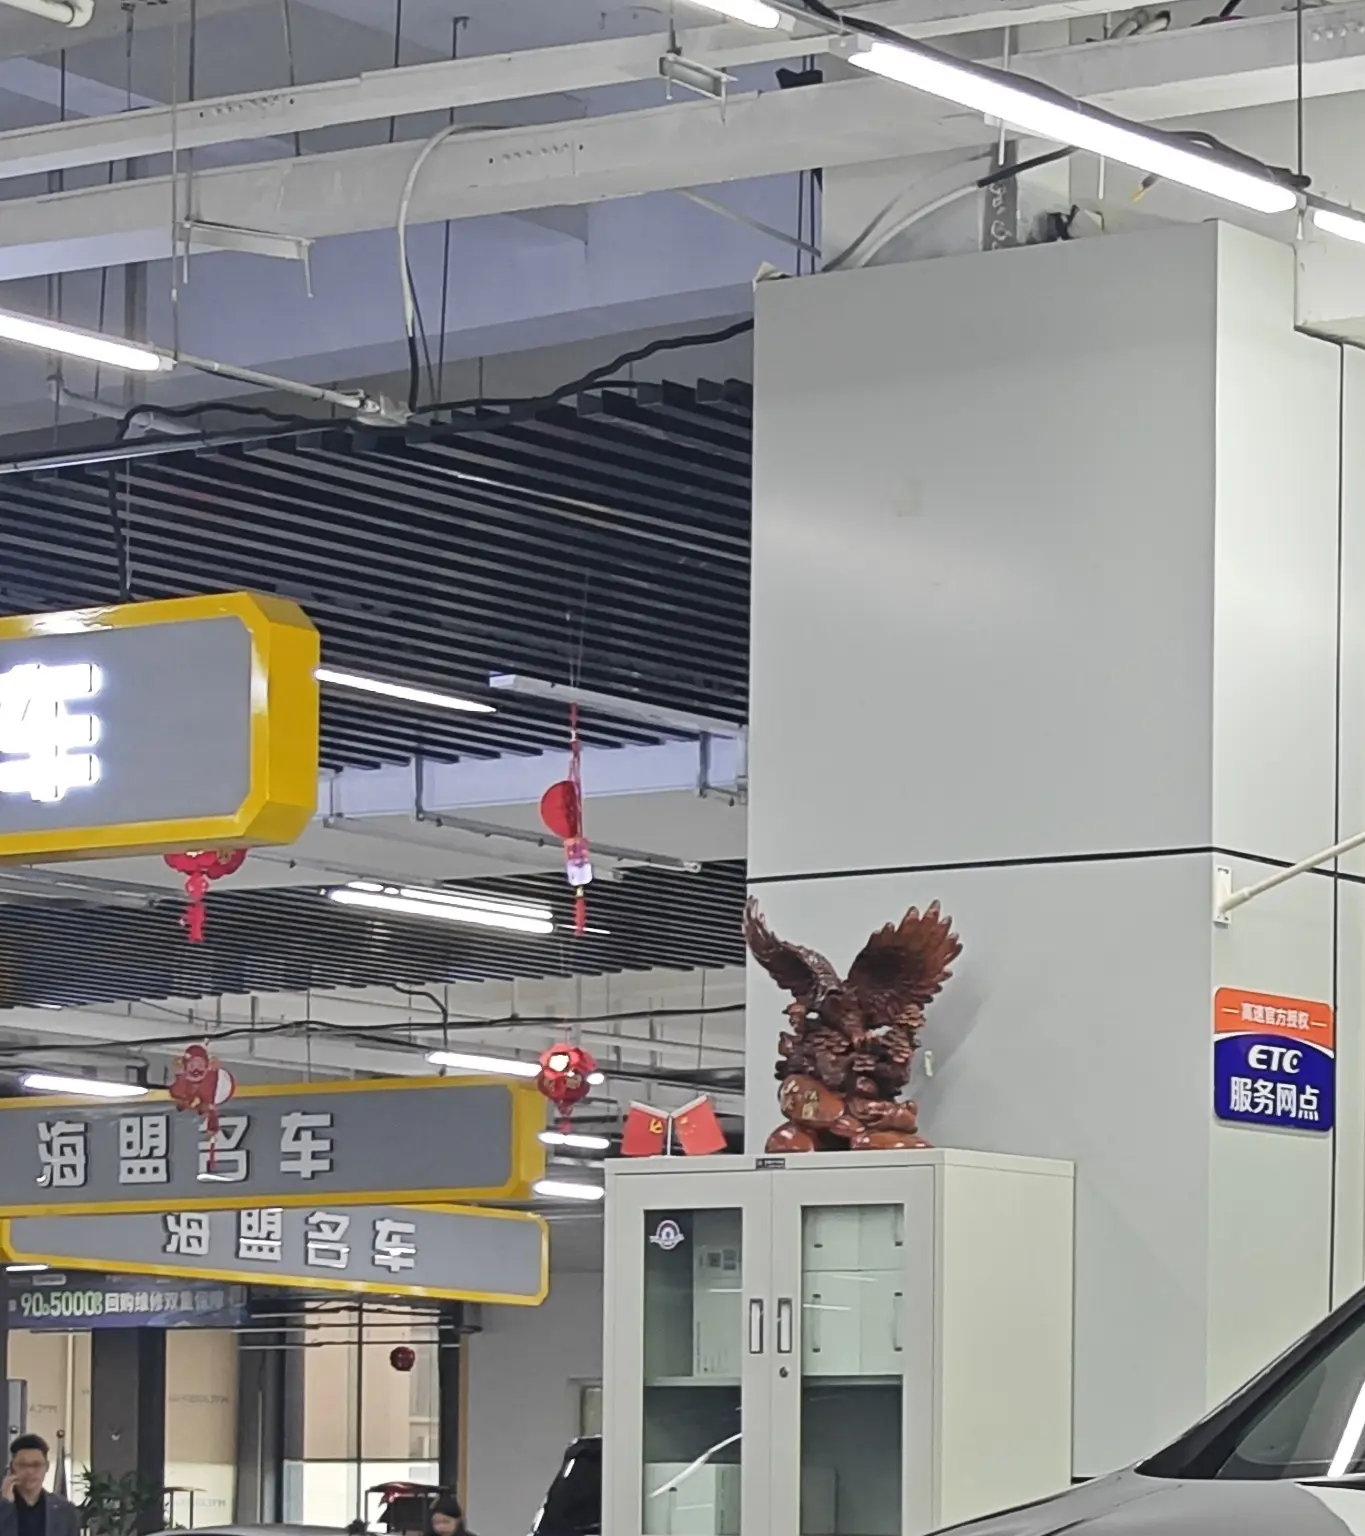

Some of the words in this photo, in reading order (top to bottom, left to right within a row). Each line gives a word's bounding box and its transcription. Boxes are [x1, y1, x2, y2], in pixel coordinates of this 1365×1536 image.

[0, 664, 102, 803] 车
[1248, 1044, 1303, 1074] ETC
[1230, 1076, 1320, 1121] 服务网点
[37, 1111, 333, 1188] 海盟名车
[165, 1207, 417, 1273] 海盟名车
